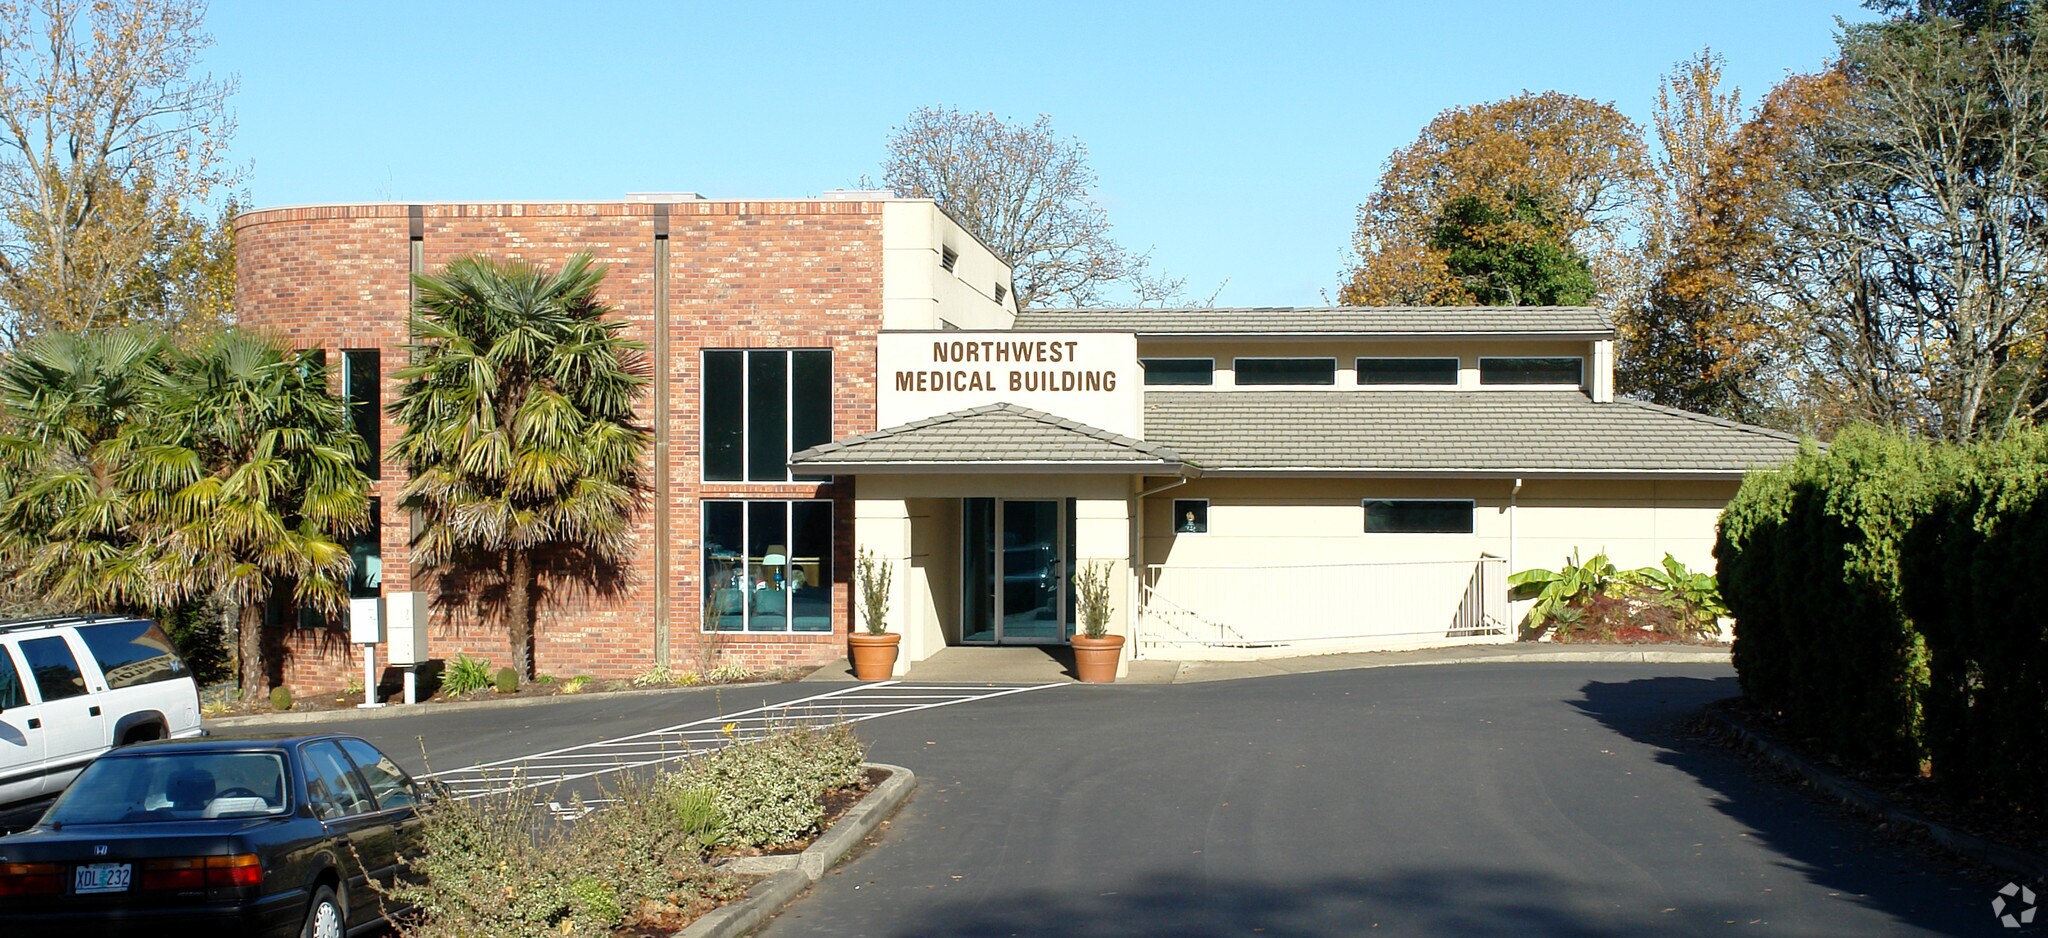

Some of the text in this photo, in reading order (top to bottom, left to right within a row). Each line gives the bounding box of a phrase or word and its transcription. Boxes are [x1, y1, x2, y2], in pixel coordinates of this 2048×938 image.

[933, 341, 1078, 362] NORTHWEST
[895, 371, 1117, 392] MEDICAL BUILDING
[77, 869, 130, 888] XDL 232
